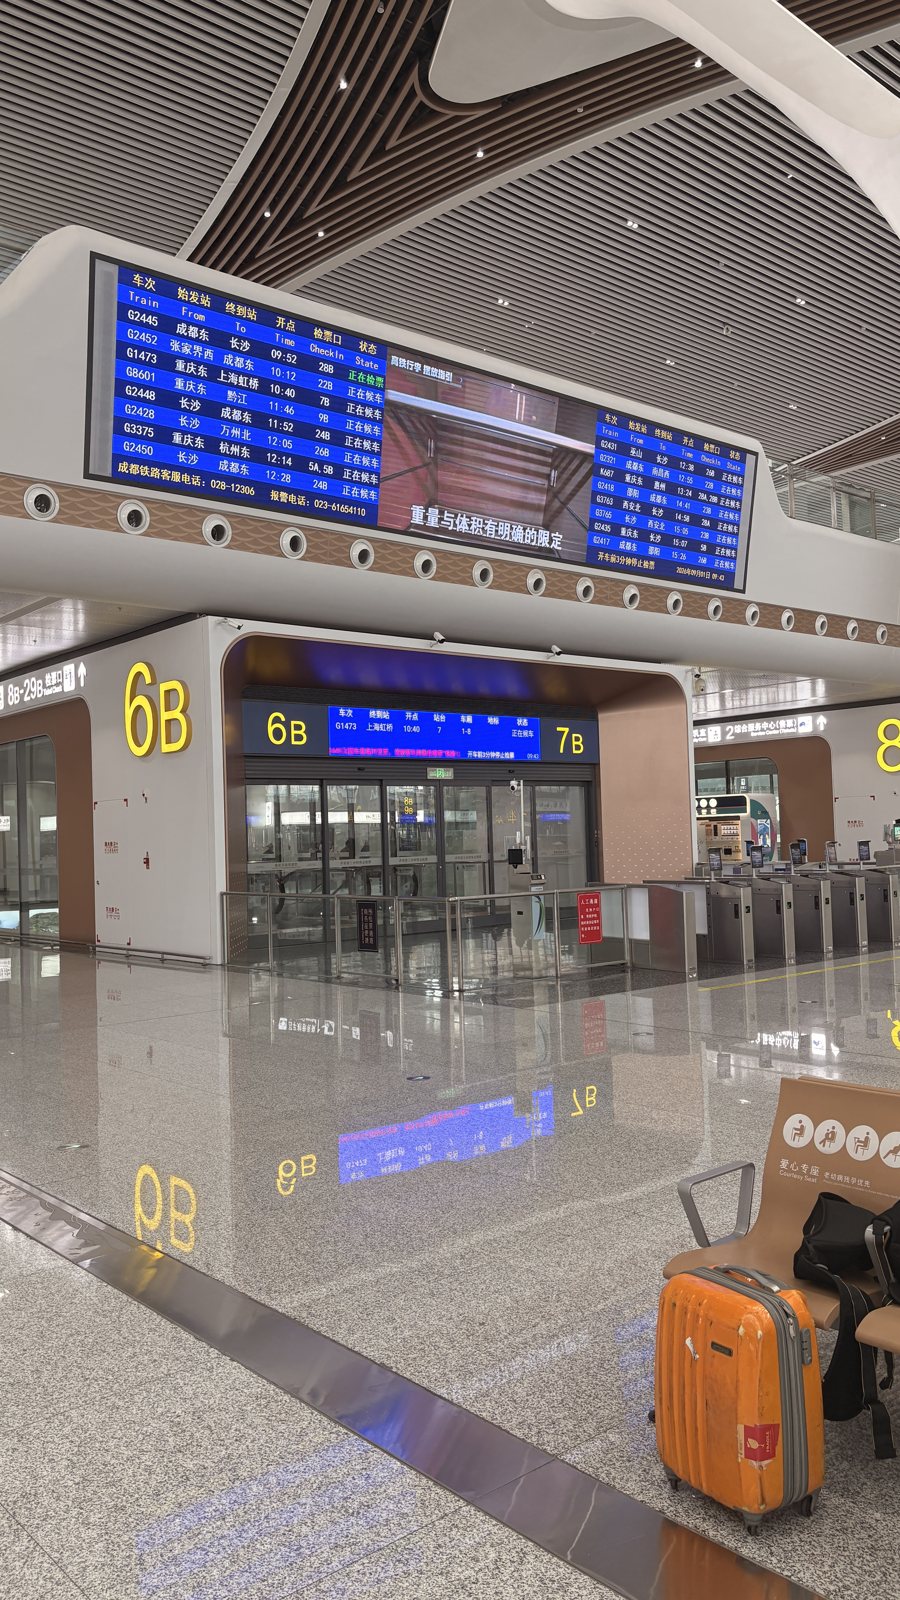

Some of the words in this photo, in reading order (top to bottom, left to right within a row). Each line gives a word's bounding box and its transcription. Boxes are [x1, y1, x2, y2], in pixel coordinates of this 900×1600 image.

[128, 290, 158, 308] Train
[182, 306, 205, 321] From
[235, 321, 246, 333] To
[275, 332, 295, 346] Time
[355, 355, 378, 370] State
[132, 273, 155, 291] 车次
[177, 286, 210, 307] 始发站
[225, 301, 257, 320] 终到站
[276, 316, 295, 332] 开点
[313, 327, 341, 345] 检票口
[358, 340, 376, 354] 状态
[127, 309, 158, 326] G2445
[176, 322, 209, 341] 成都东
[229, 336, 250, 351] 长沙
[271, 349, 297, 364] 09:52
[318, 361, 333, 373] 28B
[348, 369, 384, 388] 正在检票
[127, 328, 157, 345] G2452
[170, 338, 213, 360] 张家界西
[223, 353, 254, 370] 成都东
[271, 366, 296, 381] 10:12
[318, 378, 332, 390] 22B
[347, 386, 382, 404] 正在候车
[391, 356, 422, 372] 高铁行李
[126, 347, 156, 363] G1473
[175, 359, 207, 377] 重庆东
[217, 369, 258, 390] 上海虹桥
[270, 384, 295, 398] 10:40
[320, 396, 329, 406] 7B
[346, 402, 382, 420] 正在候车
[126, 366, 154, 381] G8601
[174, 377, 206, 394] 重庆东
[226, 390, 247, 404] 黔江
[269, 401, 294, 415] 11:46
[318, 412, 328, 423] 9B
[345, 419, 380, 436] 正在候车
[124, 404, 154, 419] G2428
[178, 414, 200, 429] 长沙
[220, 424, 251, 440] 万州北
[267, 435, 292, 449] 12:05
[314, 445, 329, 457] 26B
[344, 452, 379, 468] 正在候车
[125, 385, 155, 400] G2448
[179, 396, 201, 411] 长沙
[220, 406, 251, 423] 成都东
[268, 418, 293, 432] 11:52
[315, 429, 330, 440] 24B
[344, 435, 380, 452] 正在候车
[123, 441, 153, 455] G2450
[176, 450, 198, 465] 长沙
[218, 459, 249, 475] 成都东
[266, 470, 290, 483] 12:28
[313, 479, 327, 490] 24B
[342, 484, 377, 500] 正在候车
[124, 422, 154, 437] G3375
[172, 432, 204, 448] 重庆东
[219, 441, 250, 458] 杭州东
[267, 452, 292, 466] 12:14
[308, 461, 333, 474] 5A,5B
[342, 468, 378, 484] 正在候车
[411, 505, 563, 550] 重量与体积有明确的限定
[8, 677, 43, 705] 8B-29B
[124, 662, 192, 757] 6B
[339, 709, 353, 718] 车次
[369, 710, 390, 719] 终到站
[405, 712, 418, 721] 开点
[433, 714, 446, 722] 站台
[267, 712, 307, 745] 6B
[366, 723, 393, 732] 上海虹桥
[556, 727, 584, 754] 7B
[726, 725, 734, 739] 2
[876, 718, 900, 773] 8
[404, 796, 413, 806] 8B
[404, 806, 413, 814] 9B
[780, 1158, 820, 1176] 爱心专座
[824, 1172, 871, 1188] 老幼病残孕优先
[780, 1170, 803, 1181] Courtesy
